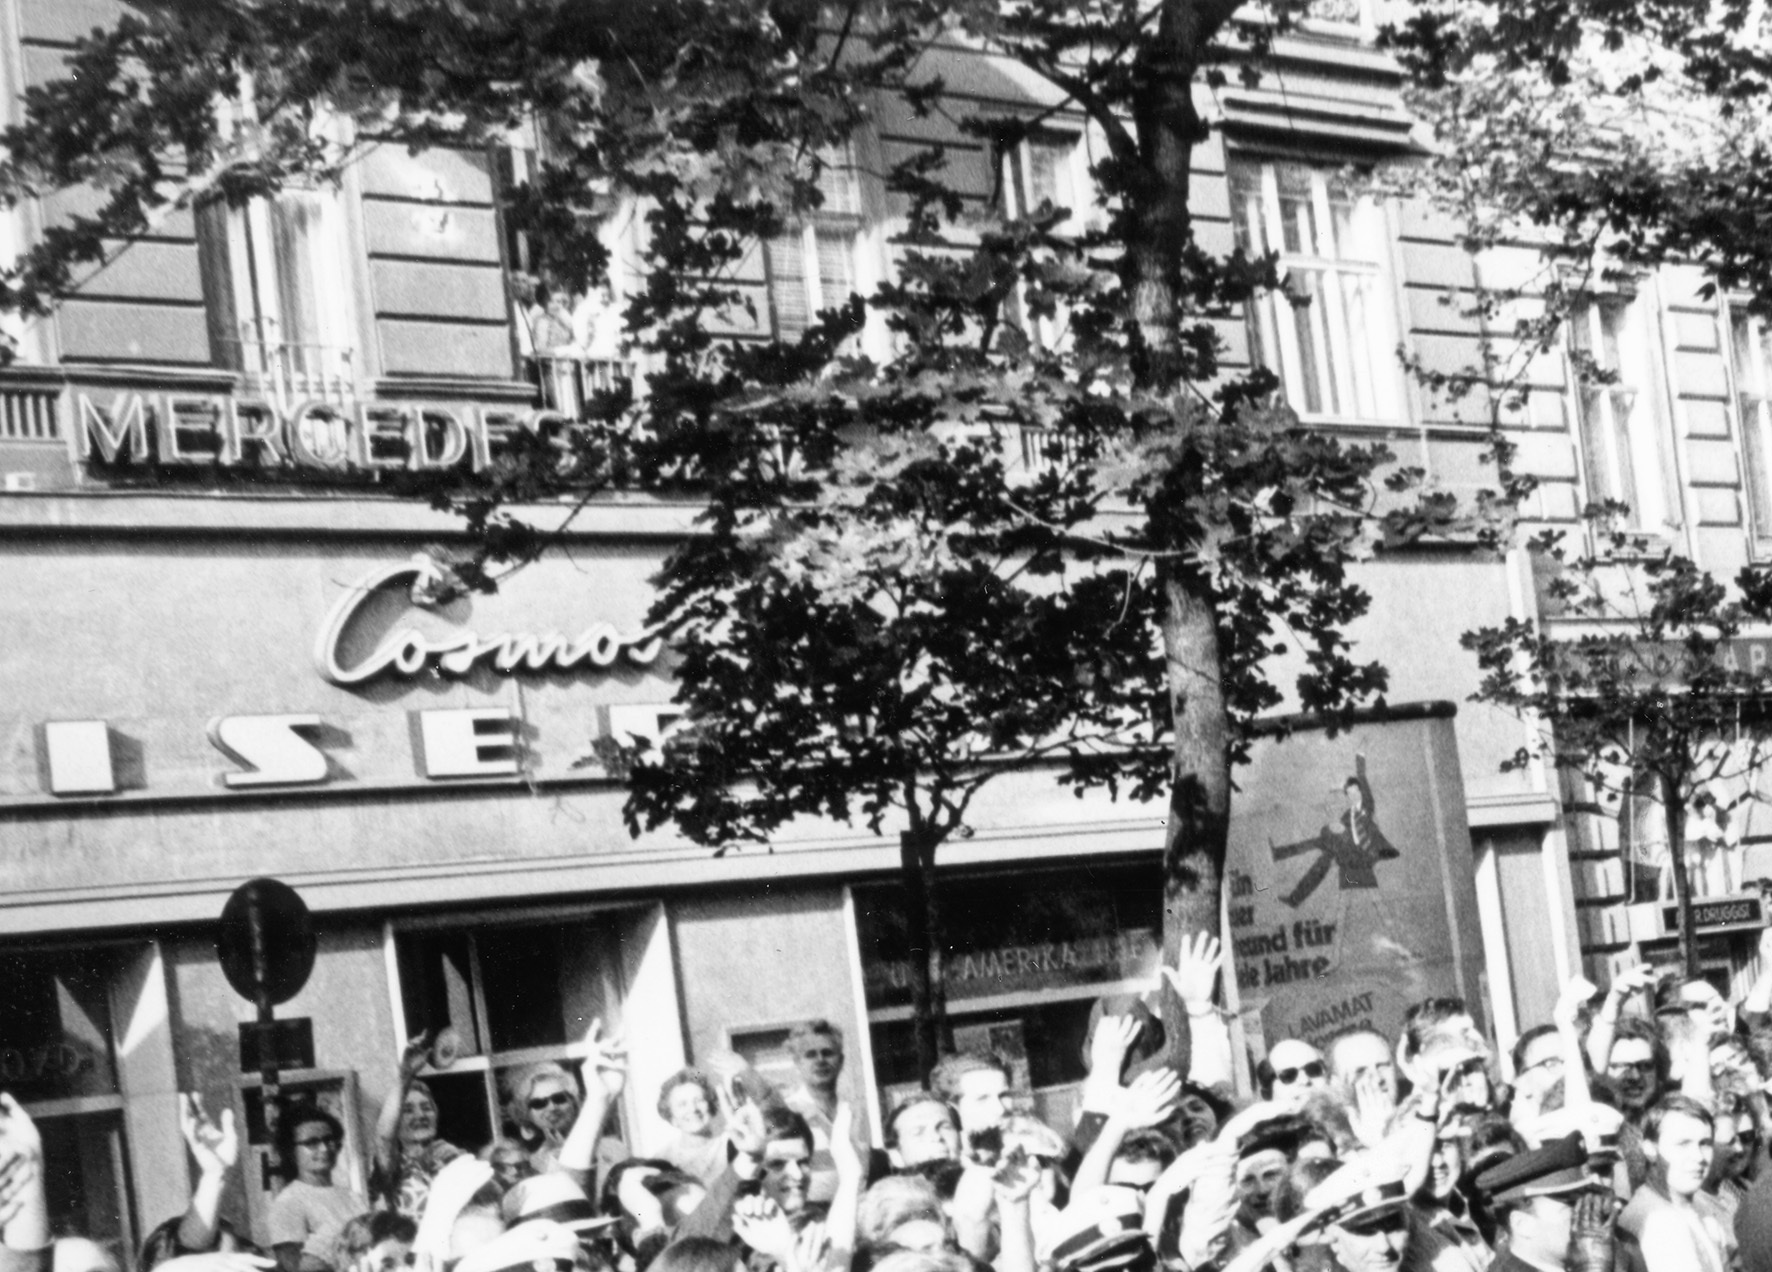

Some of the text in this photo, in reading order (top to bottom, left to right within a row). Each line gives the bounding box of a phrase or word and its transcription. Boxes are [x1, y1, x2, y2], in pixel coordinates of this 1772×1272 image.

[1293, 919, 1336, 949] für
[963, 942, 1076, 981] AMERIKA
[1264, 956, 1330, 988] Jahre
[1288, 991, 1374, 1040] LAVAMAT
